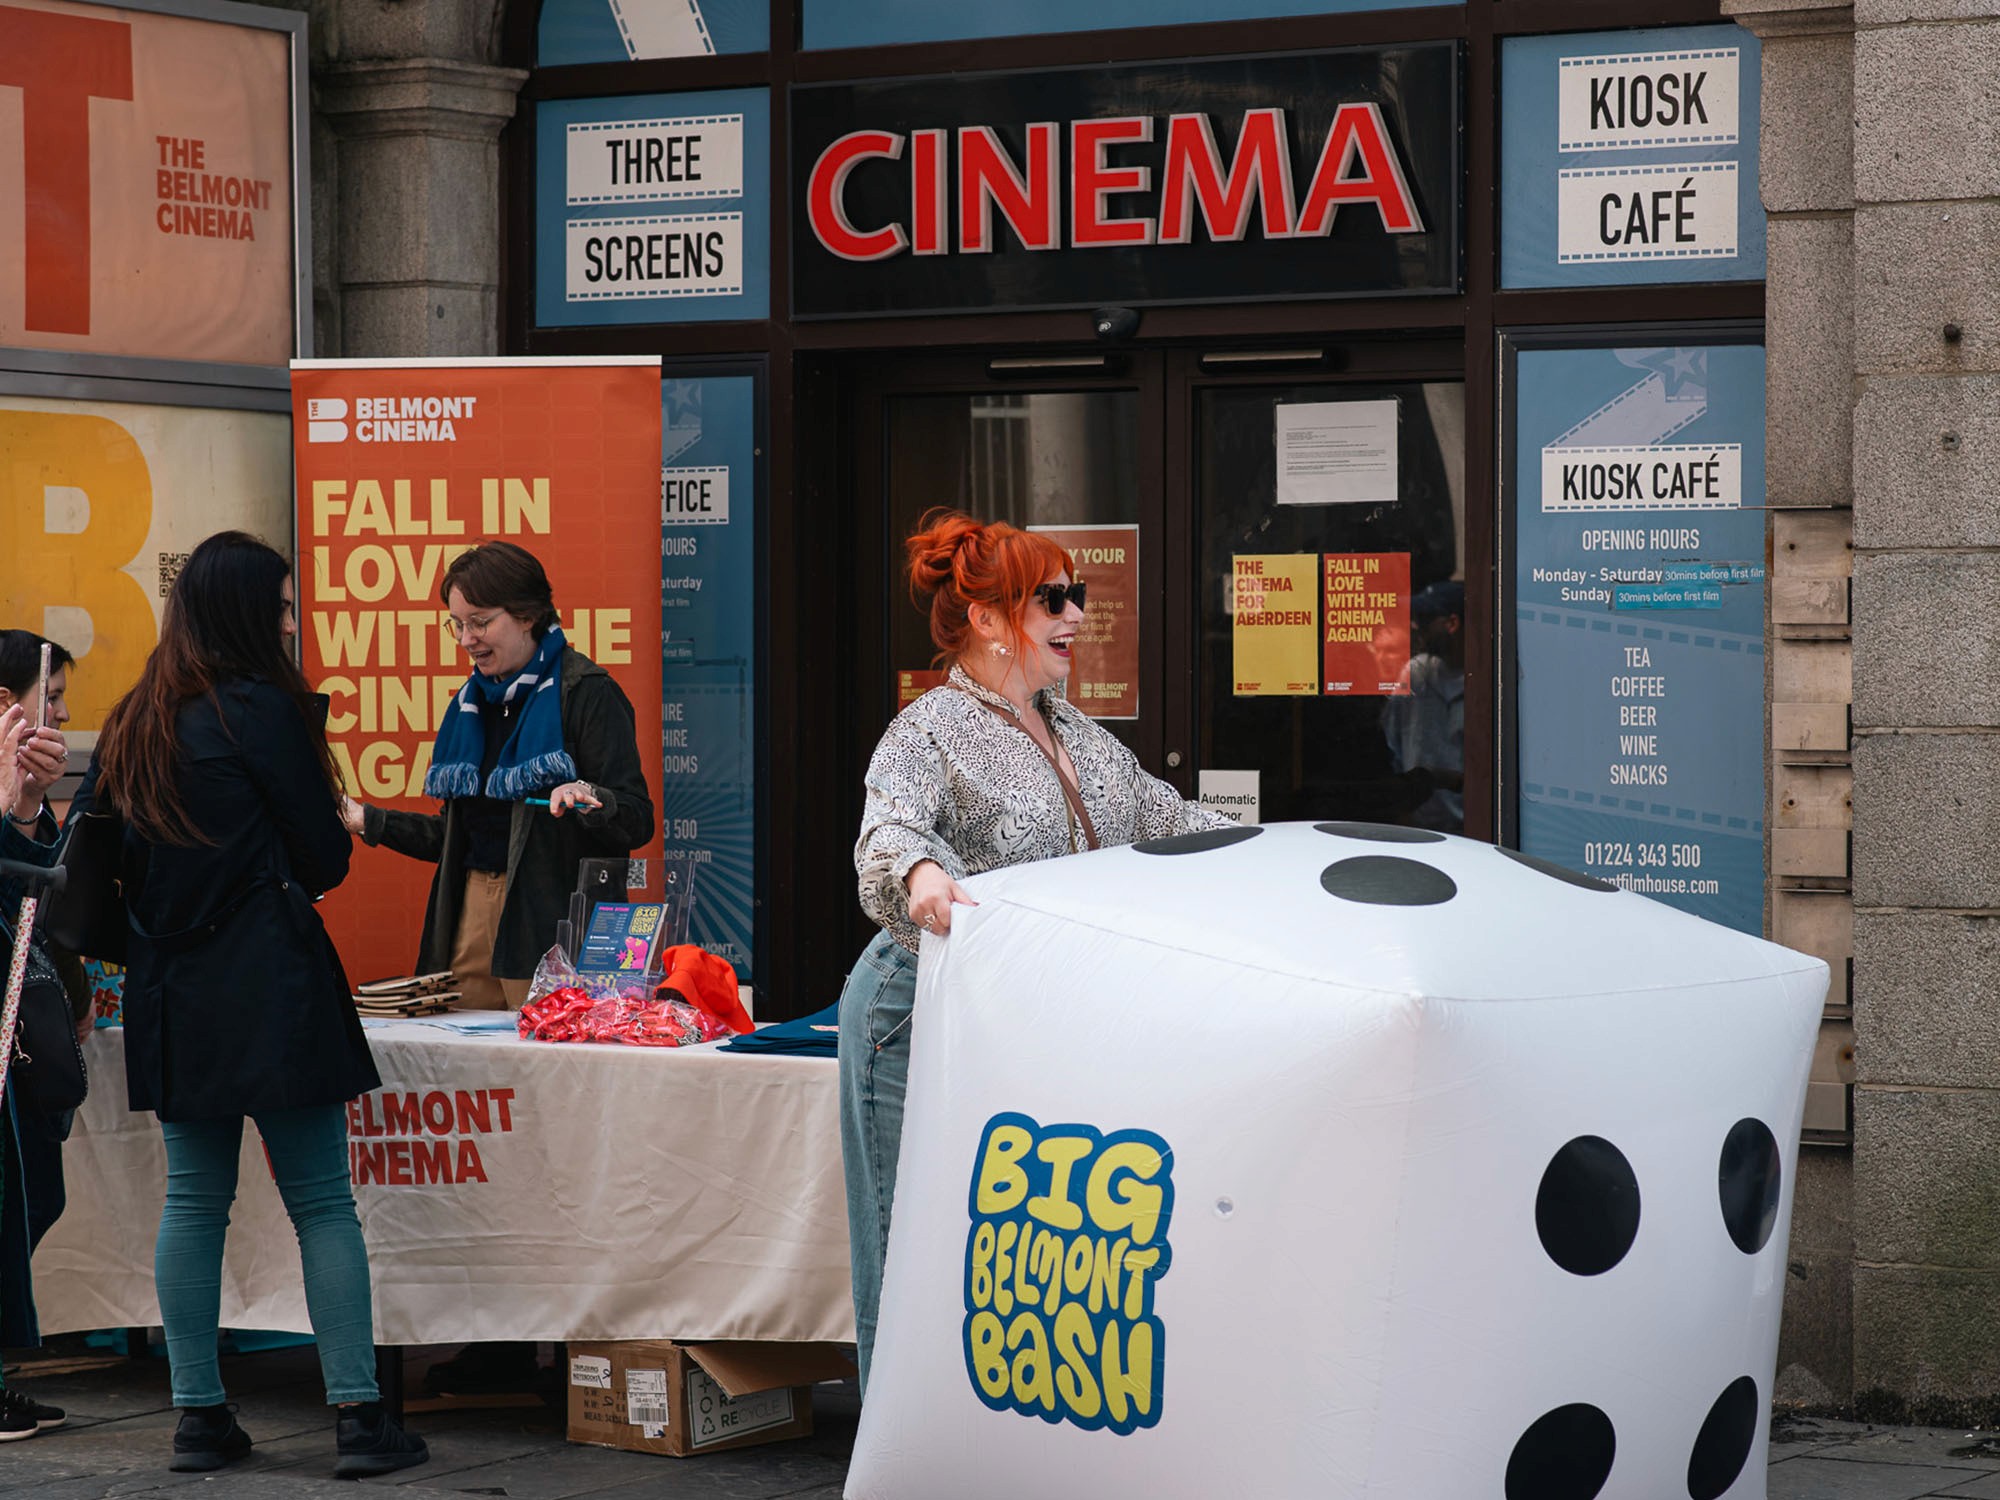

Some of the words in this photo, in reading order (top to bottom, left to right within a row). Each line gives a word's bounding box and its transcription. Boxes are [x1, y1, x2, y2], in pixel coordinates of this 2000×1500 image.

[1588, 71, 1709, 130] KIOSK
[156, 135, 205, 170] THE
[606, 135, 702, 185] THREE
[157, 169, 272, 211] BELMONT
[807, 101, 1426, 262] CINEMA
[156, 202, 255, 242] CINEMA
[1598, 177, 1697, 246] CAFÉ
[584, 231, 724, 282] SCREENS
[355, 396, 477, 420] BELMONT
[355, 420, 457, 443] CINEMA
[1562, 463, 1643, 501] KIOSK
[1653, 453, 1720, 499] CAFÉ
[312, 478, 465, 537] FALL
[481, 477, 551, 535] IN
[661, 479, 712, 513] FICE
[1582, 529, 1645, 551] OPENING
[1650, 528, 1700, 550] HOURS
[1081, 548, 1125, 564] YOUR
[1327, 559, 1361, 574] FALL
[1364, 558, 1379, 573] IN
[313, 544, 479, 602] LOV
[1236, 560, 1263, 575] THE
[1533, 568, 1587, 584] Monday
[1600, 567, 1664, 585] Saturday
[1665, 571, 1698, 581] 30mins
[1700, 569, 1729, 581] before
[1731, 568, 1749, 579] first
[661, 576, 702, 592] aturday
[1236, 577, 1293, 592] CINEMA
[1327, 576, 1364, 591] LOVE
[1236, 595, 1265, 609] FOR
[1327, 593, 1365, 608] WITH
[1368, 593, 1397, 608] THE
[1561, 587, 1612, 604] Sunday
[1619, 592, 1651, 603] 30mins
[1653, 591, 1682, 602] before
[1684, 591, 1701, 601] first
[1703, 590, 1719, 601] film
[1236, 611, 1312, 626] ABERDEEN
[1327, 610, 1385, 625] CINEMA
[559, 607, 633, 665] HE
[1327, 627, 1373, 642] AGAIN
[1624, 647, 1651, 668] TEA
[1611, 676, 1665, 697] COFFEE
[316, 675, 470, 734] CINE
[1620, 706, 1657, 726] BEER
[1620, 735, 1657, 756] WINE
[662, 754, 698, 774] OOMS
[1610, 764, 1668, 785] SNACKS
[1201, 793, 1257, 805] Automatic
[674, 818, 698, 840] 500
[1585, 842, 1633, 866] 01224
[1638, 844, 1667, 867] 343
[1672, 844, 1701, 868] 500
[345, 1087, 515, 1137] ELMONT
[351, 1139, 489, 1185] INEMA
[976, 1124, 1164, 1246] BIG
